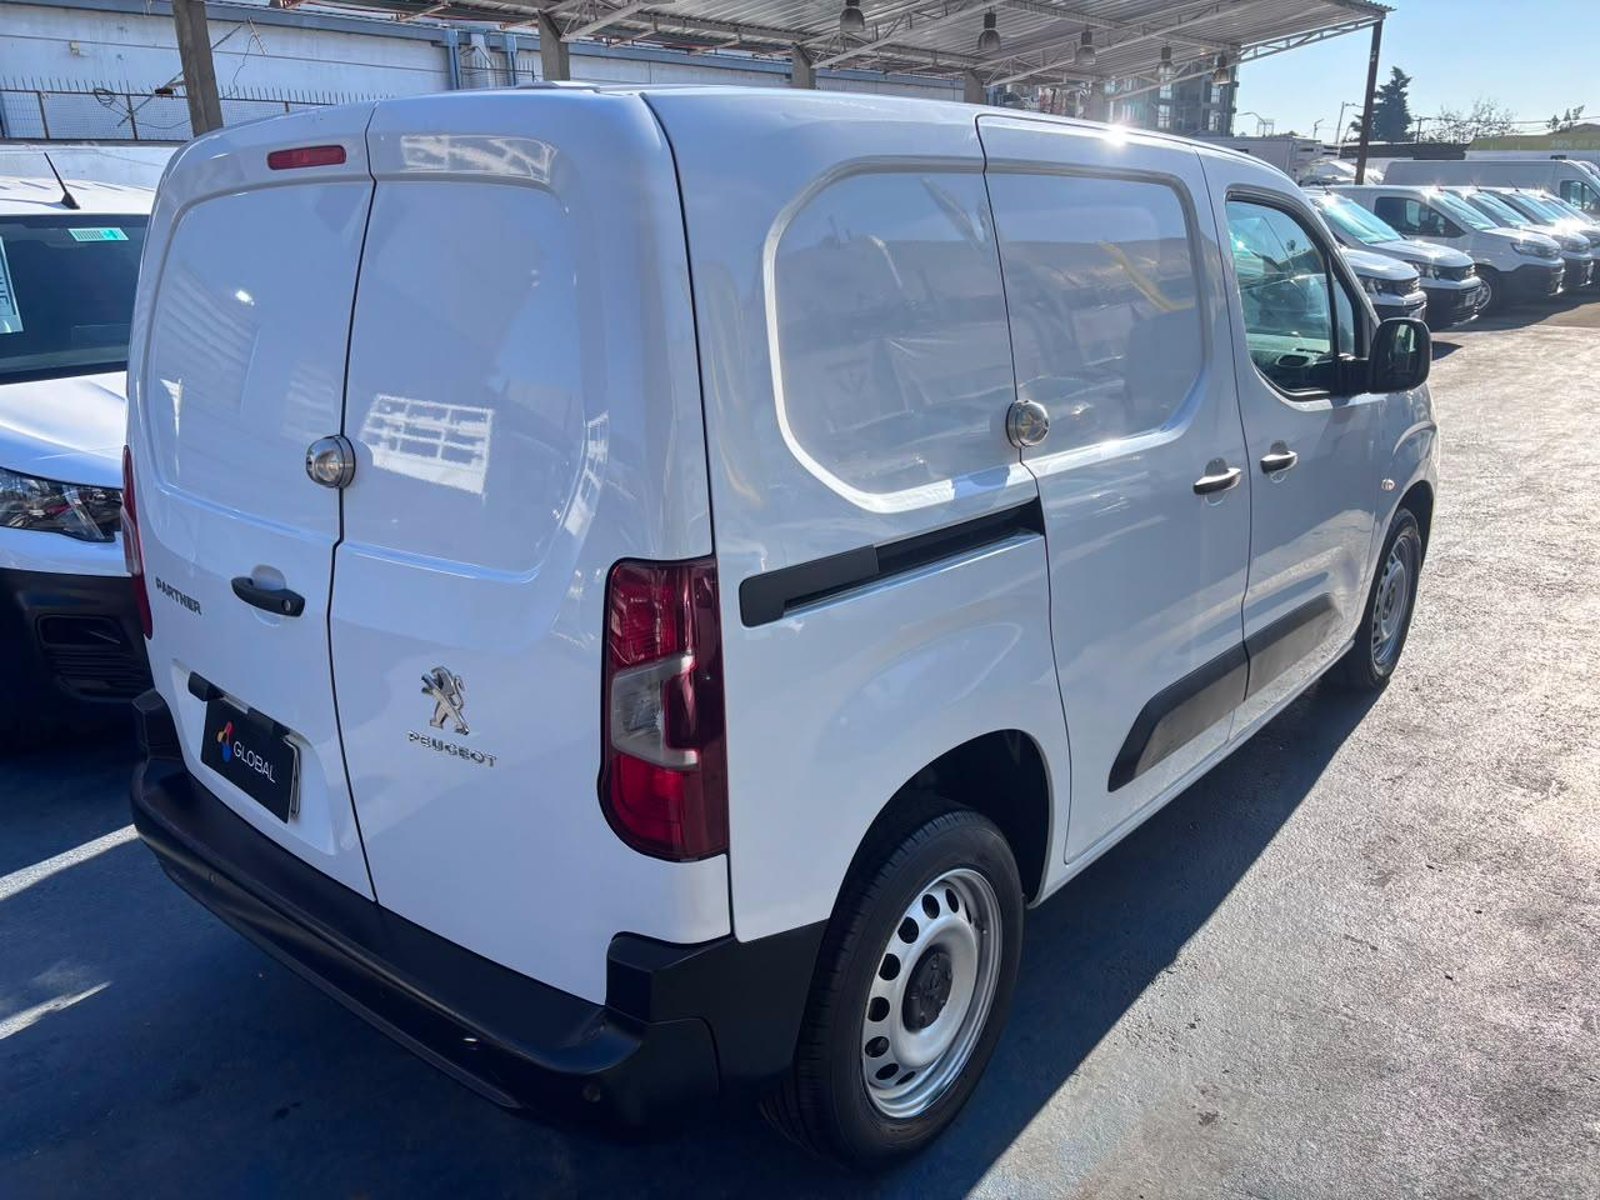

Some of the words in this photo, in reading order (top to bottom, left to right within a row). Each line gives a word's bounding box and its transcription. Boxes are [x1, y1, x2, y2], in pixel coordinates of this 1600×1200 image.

[155, 577, 202, 615] PARTNER
[233, 742, 276, 784] GLOBAL
[408, 730, 497, 767] PEUGEOT
